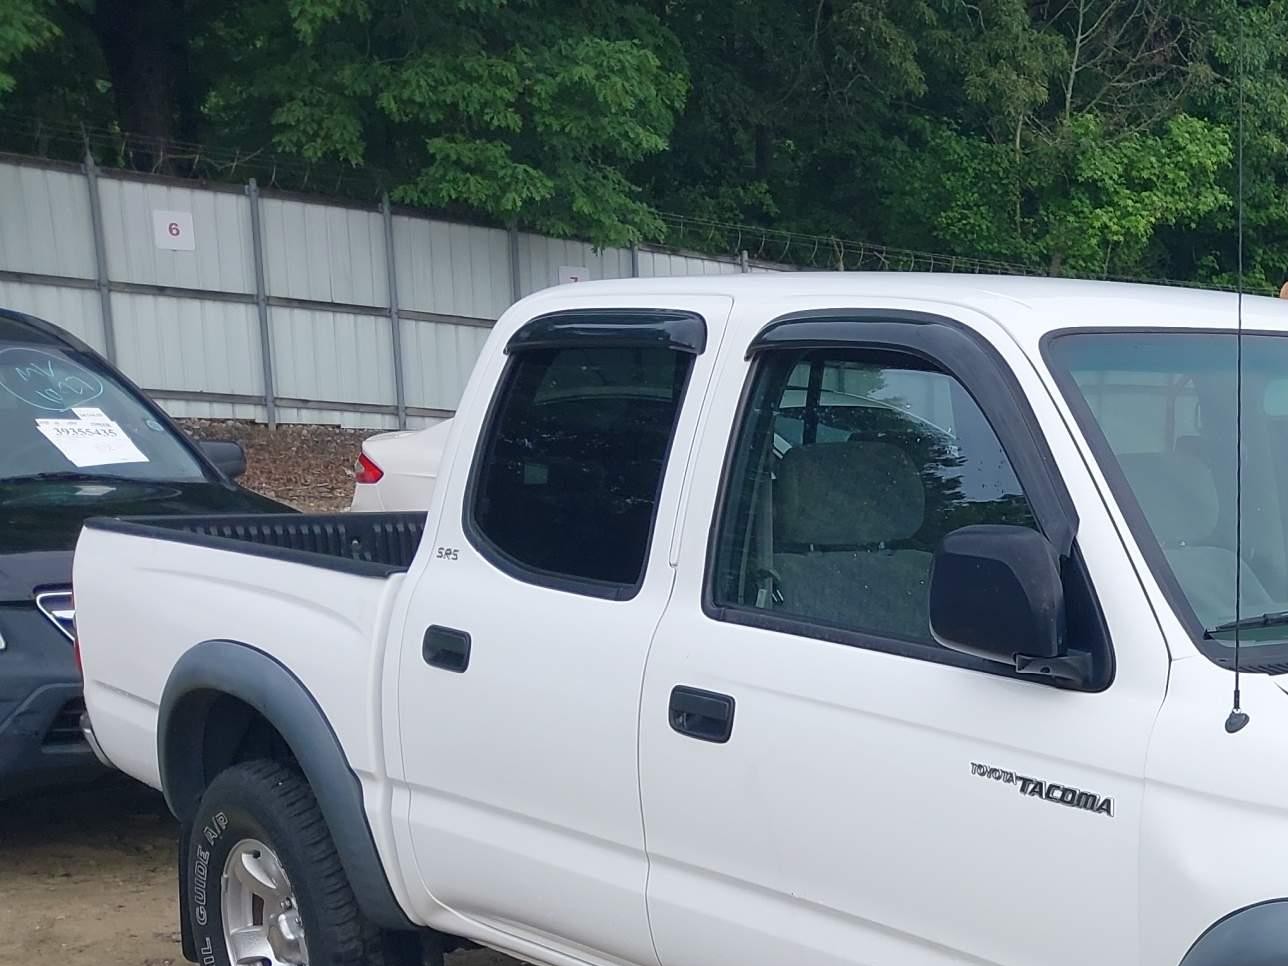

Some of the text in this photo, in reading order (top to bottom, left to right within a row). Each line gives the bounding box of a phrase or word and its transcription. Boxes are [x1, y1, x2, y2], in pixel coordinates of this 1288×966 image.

[168, 222, 180, 237] 6
[970, 761, 1114, 817] TOYOTA TACOMA
[195, 845, 211, 926] GUIDE
[203, 811, 229, 846] A/P
